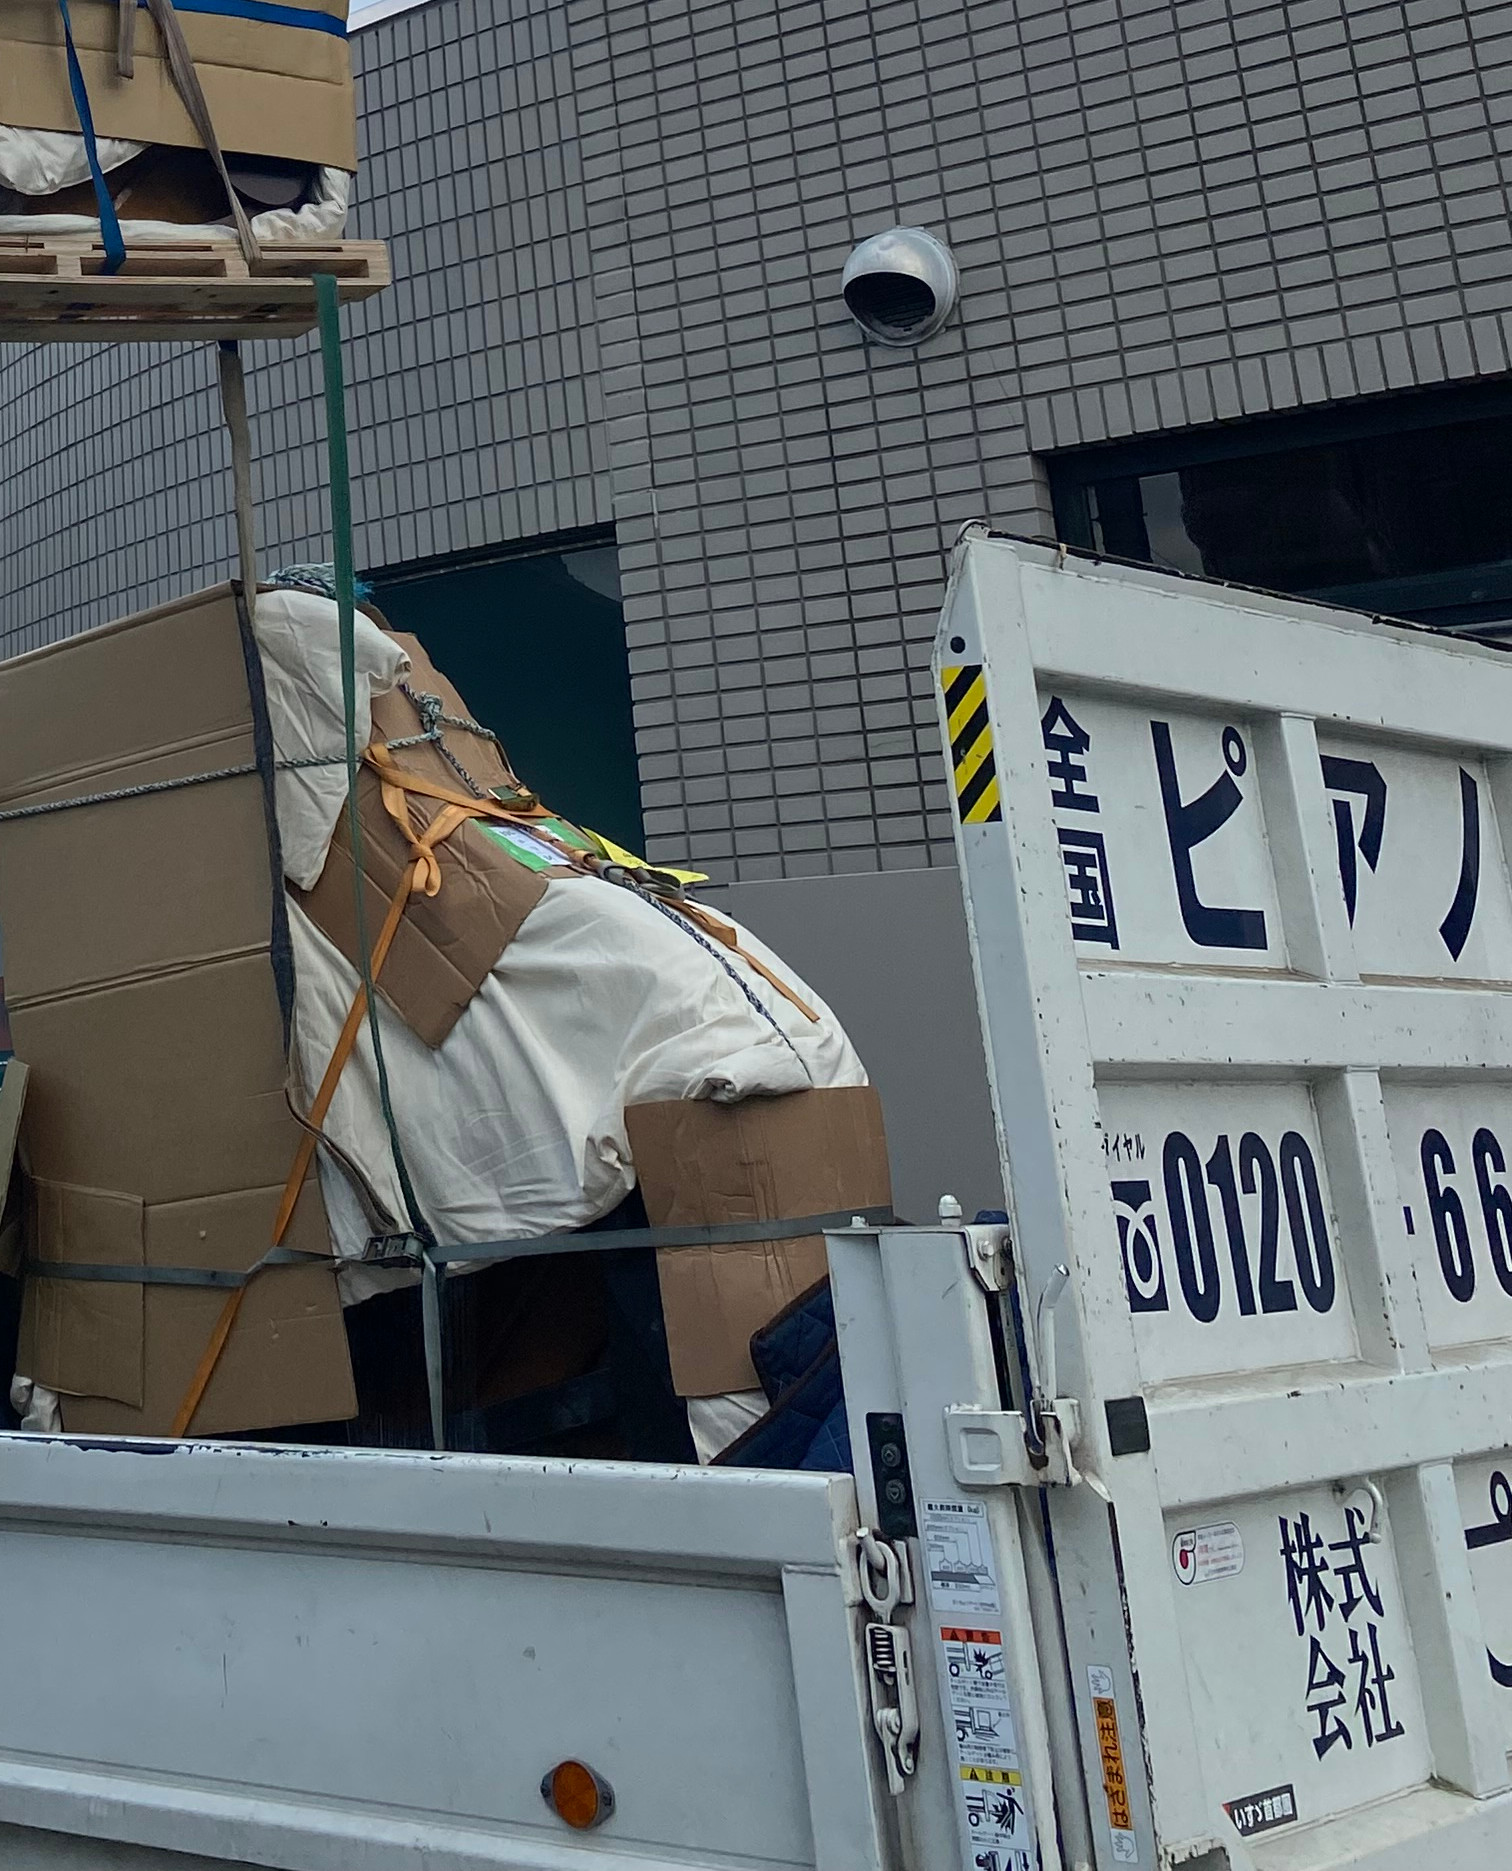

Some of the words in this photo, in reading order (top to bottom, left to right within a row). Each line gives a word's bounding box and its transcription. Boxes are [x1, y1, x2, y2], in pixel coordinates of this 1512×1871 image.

[1040, 695, 1121, 951] 全国
[1149, 720, 1481, 964] ピアノ
[1279, 1506, 1386, 1636] 株式
[1306, 1622, 1406, 1761] 会社
